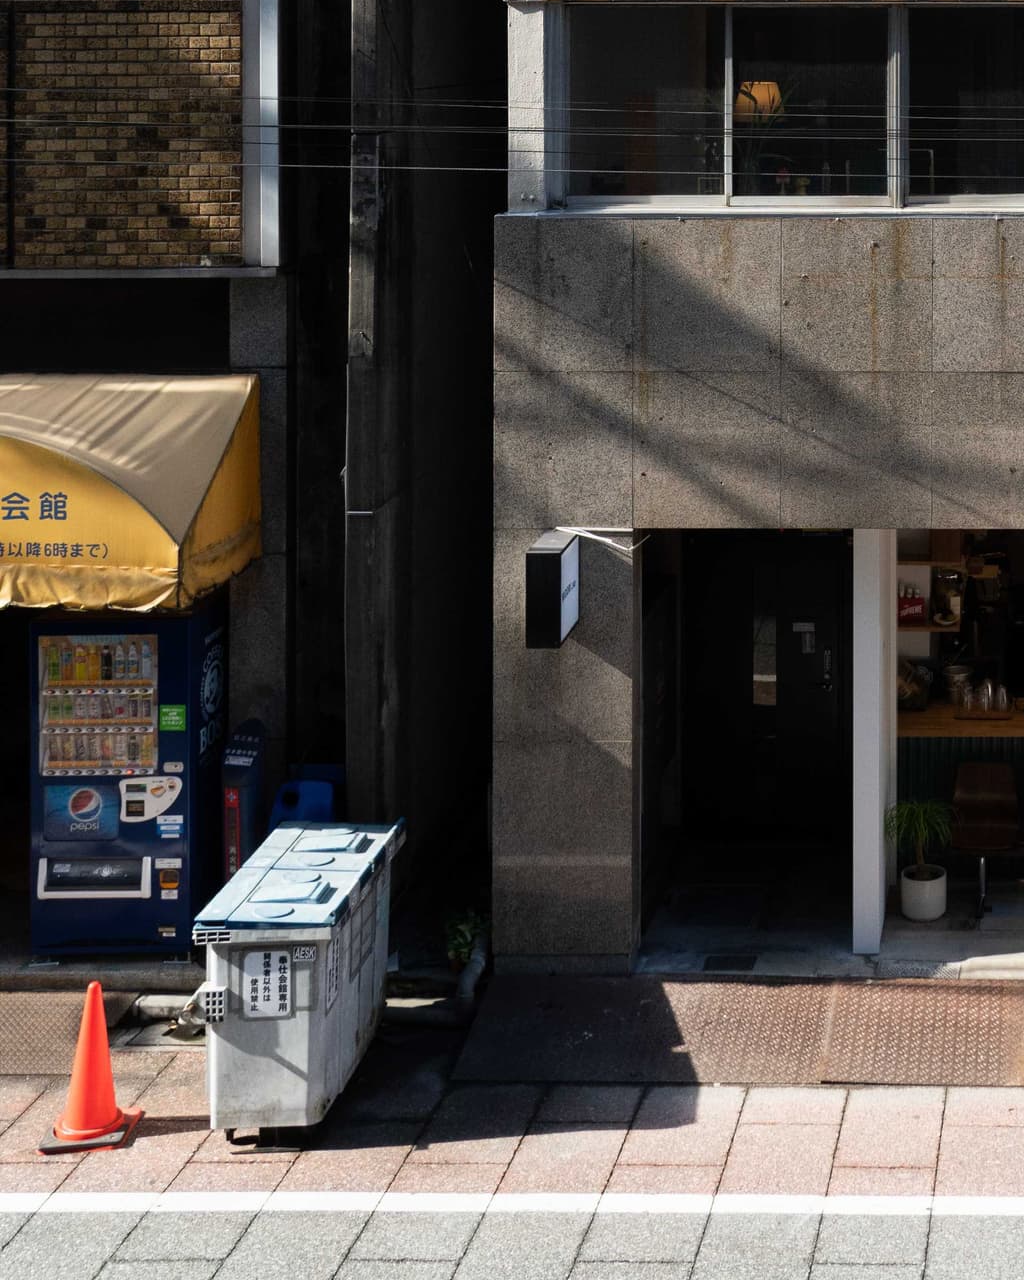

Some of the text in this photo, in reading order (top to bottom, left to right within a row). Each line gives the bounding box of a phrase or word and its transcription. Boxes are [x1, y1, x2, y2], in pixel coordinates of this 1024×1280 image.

[2, 492, 68, 521] 会館
[70, 822, 99, 832] pepsi
[263, 952, 272, 1002] 関係者以外は
[250, 978, 259, 1012] 使用禁止
